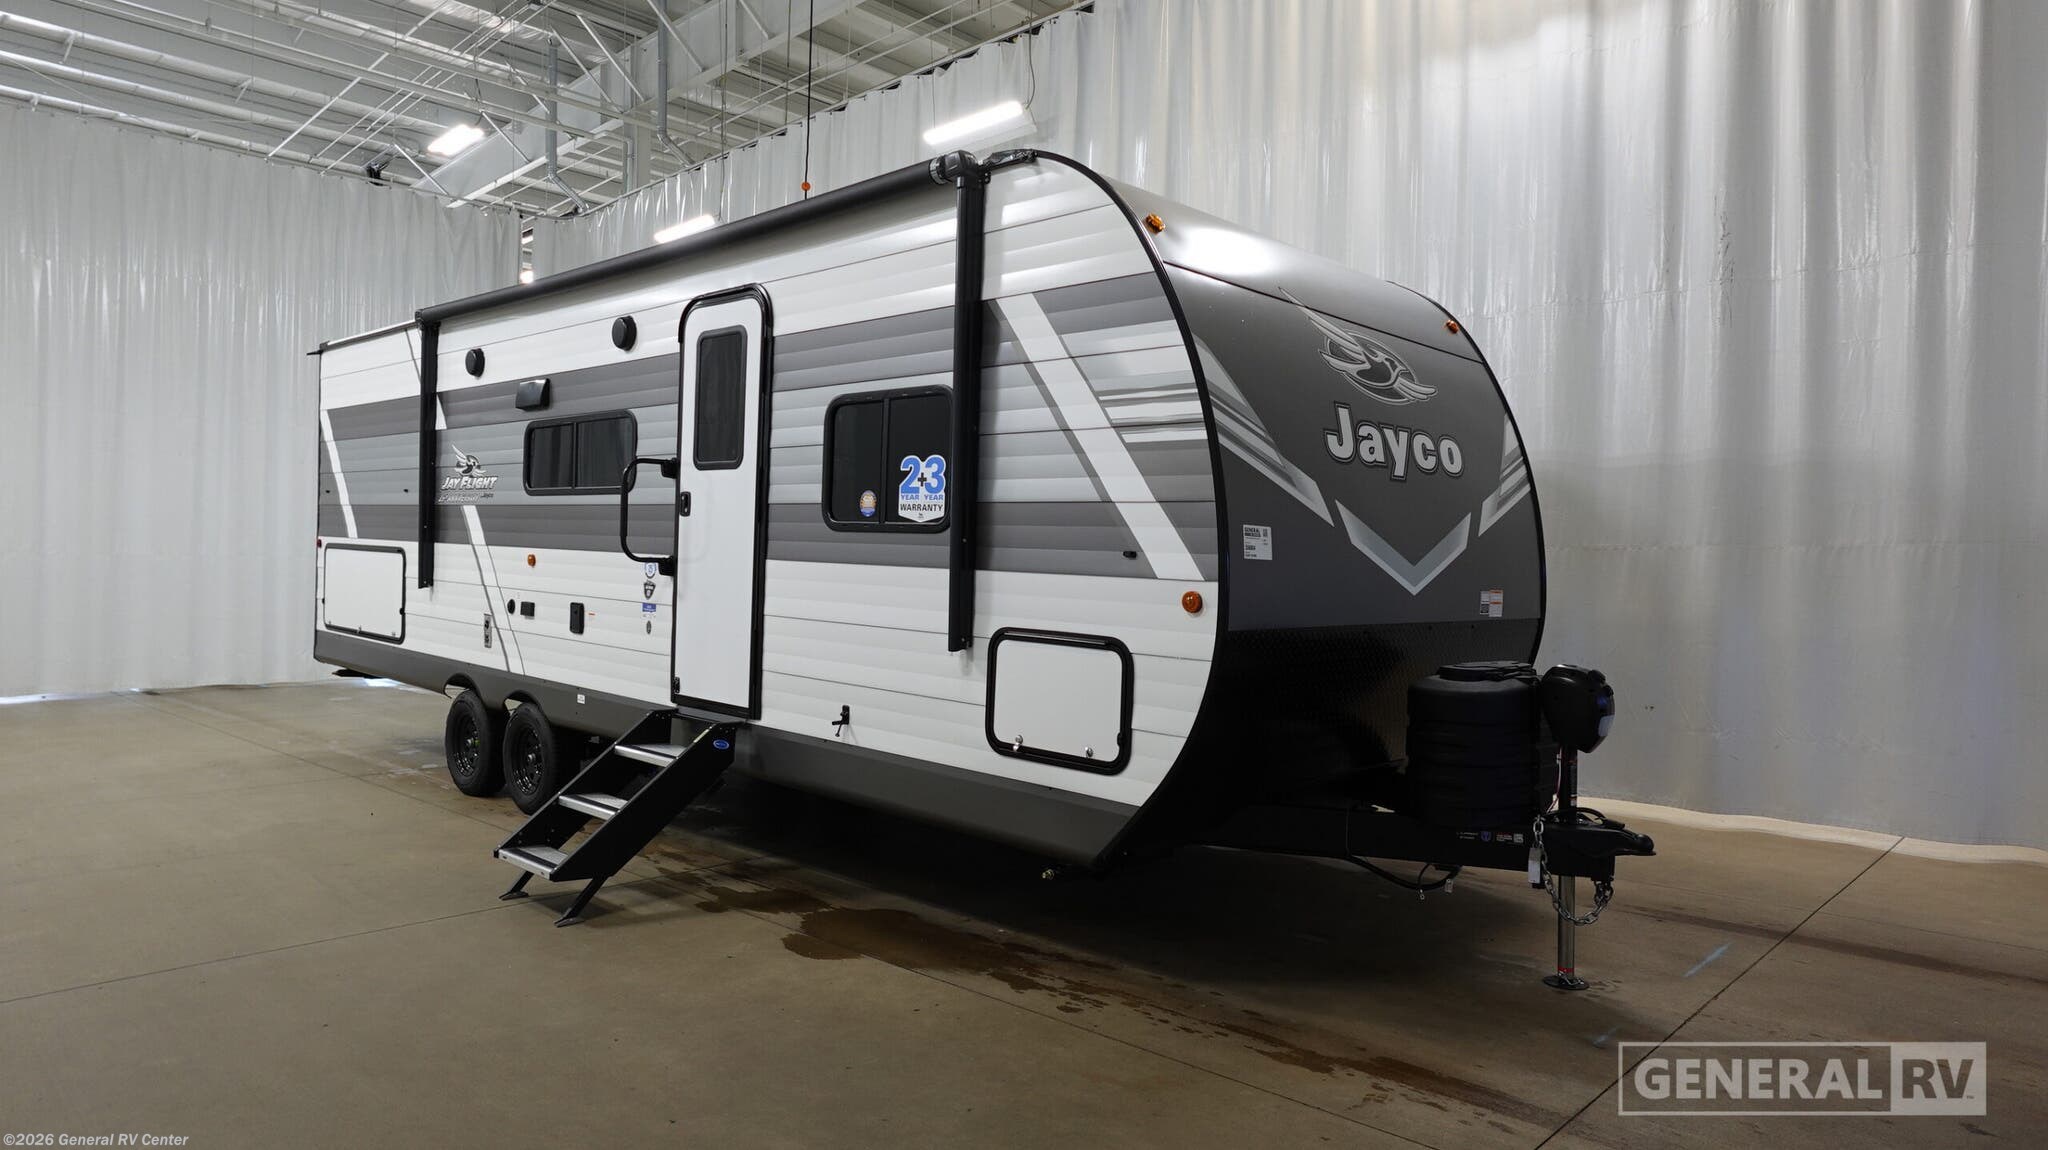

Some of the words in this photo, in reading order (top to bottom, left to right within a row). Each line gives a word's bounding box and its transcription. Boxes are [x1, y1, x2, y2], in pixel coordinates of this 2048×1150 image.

[1324, 402, 1463, 480] Jayco
[441, 476, 461, 490] JAY
[460, 475, 498, 490] FLIGHT
[900, 503, 944, 512] WARRANTY
